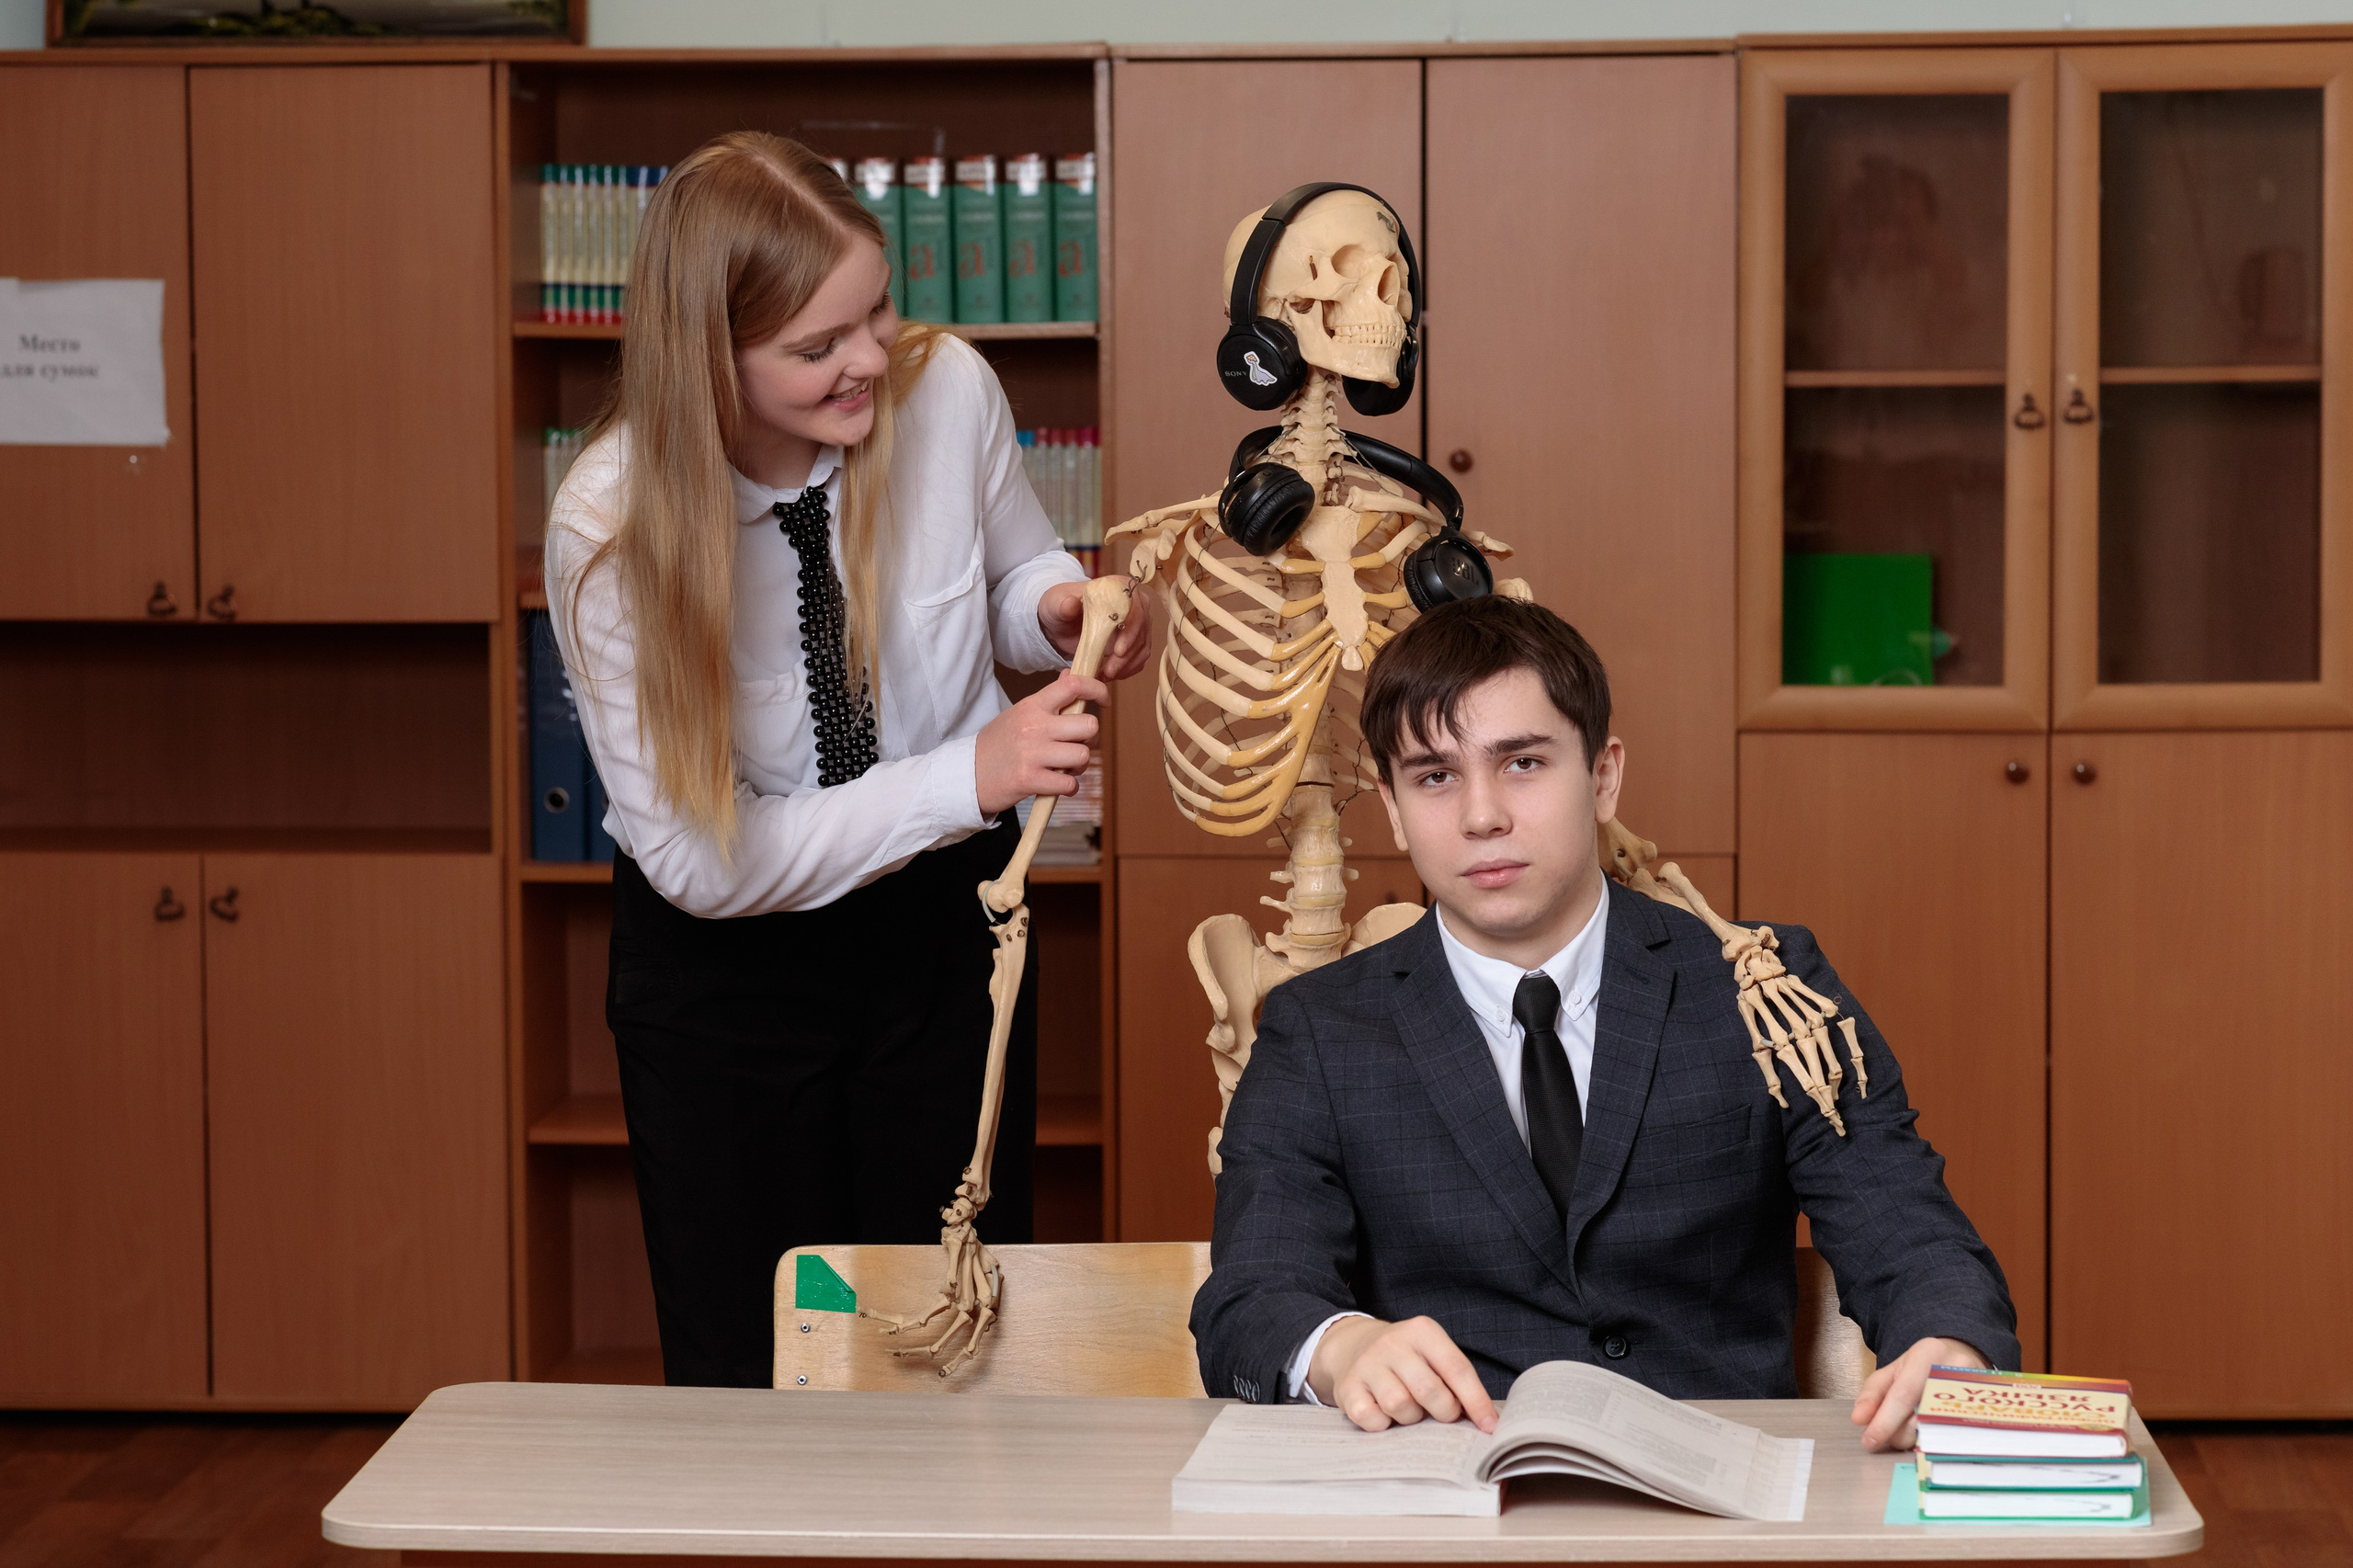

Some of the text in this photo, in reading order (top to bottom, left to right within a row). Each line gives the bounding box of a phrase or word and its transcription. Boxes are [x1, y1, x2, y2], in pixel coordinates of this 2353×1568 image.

[1933, 1392, 2115, 1412] РУССКОГО
[1962, 1387, 2091, 1403] ЯЗЫКА
[1941, 1401, 2105, 1417] СЛОВАРЬ
